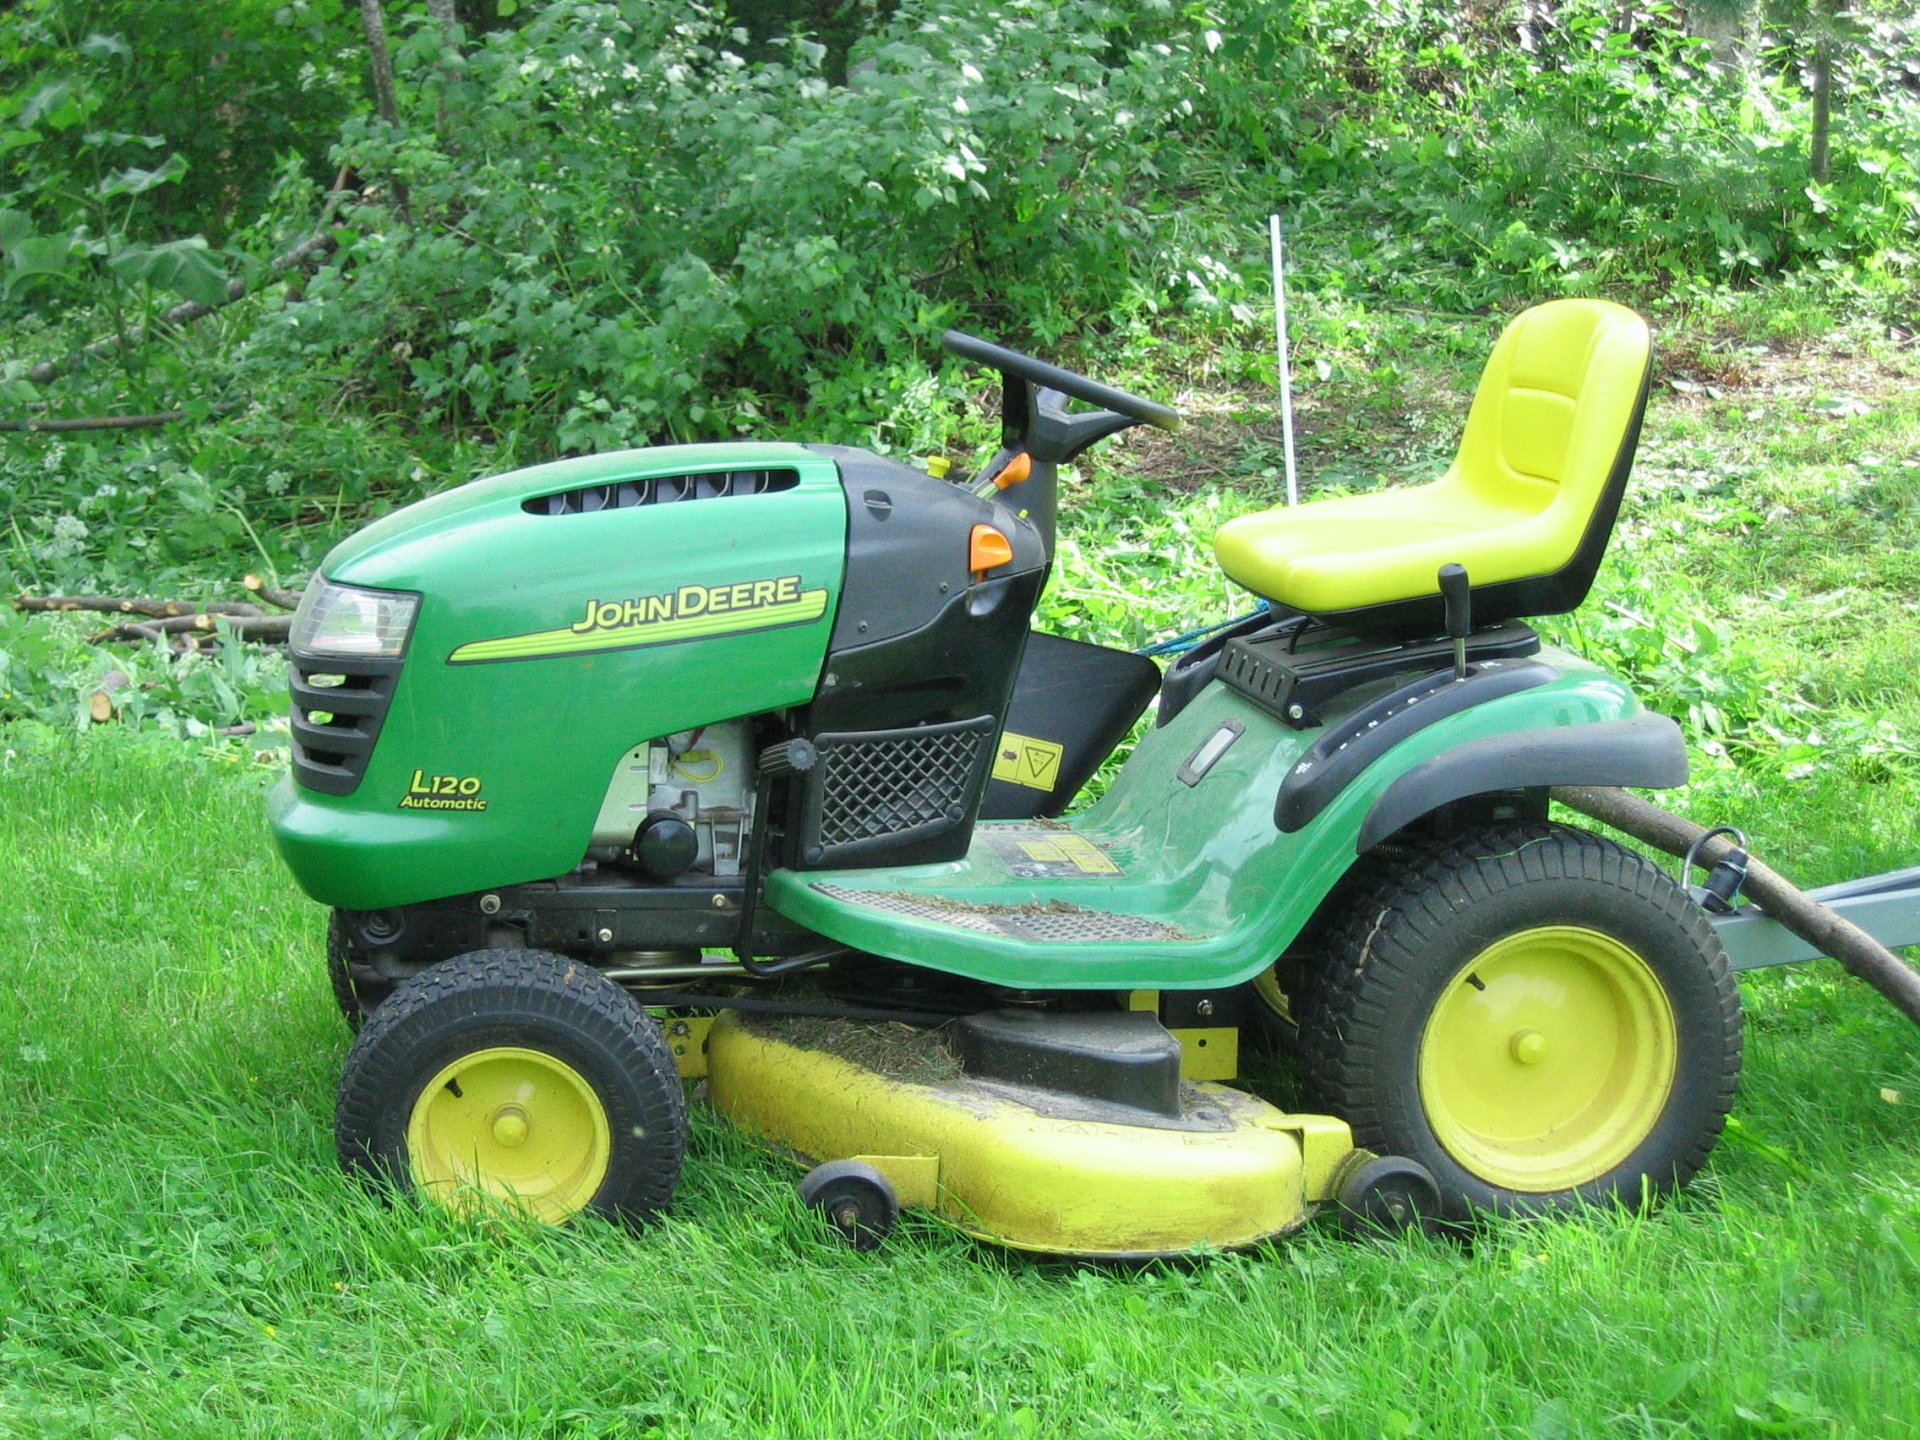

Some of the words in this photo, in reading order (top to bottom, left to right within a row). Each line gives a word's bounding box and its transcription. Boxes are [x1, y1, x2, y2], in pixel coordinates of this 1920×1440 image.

[572, 593, 674, 633] JOHN
[676, 575, 801, 618] DEERE
[410, 769, 481, 795] L120
[399, 795, 487, 811] Automatic
